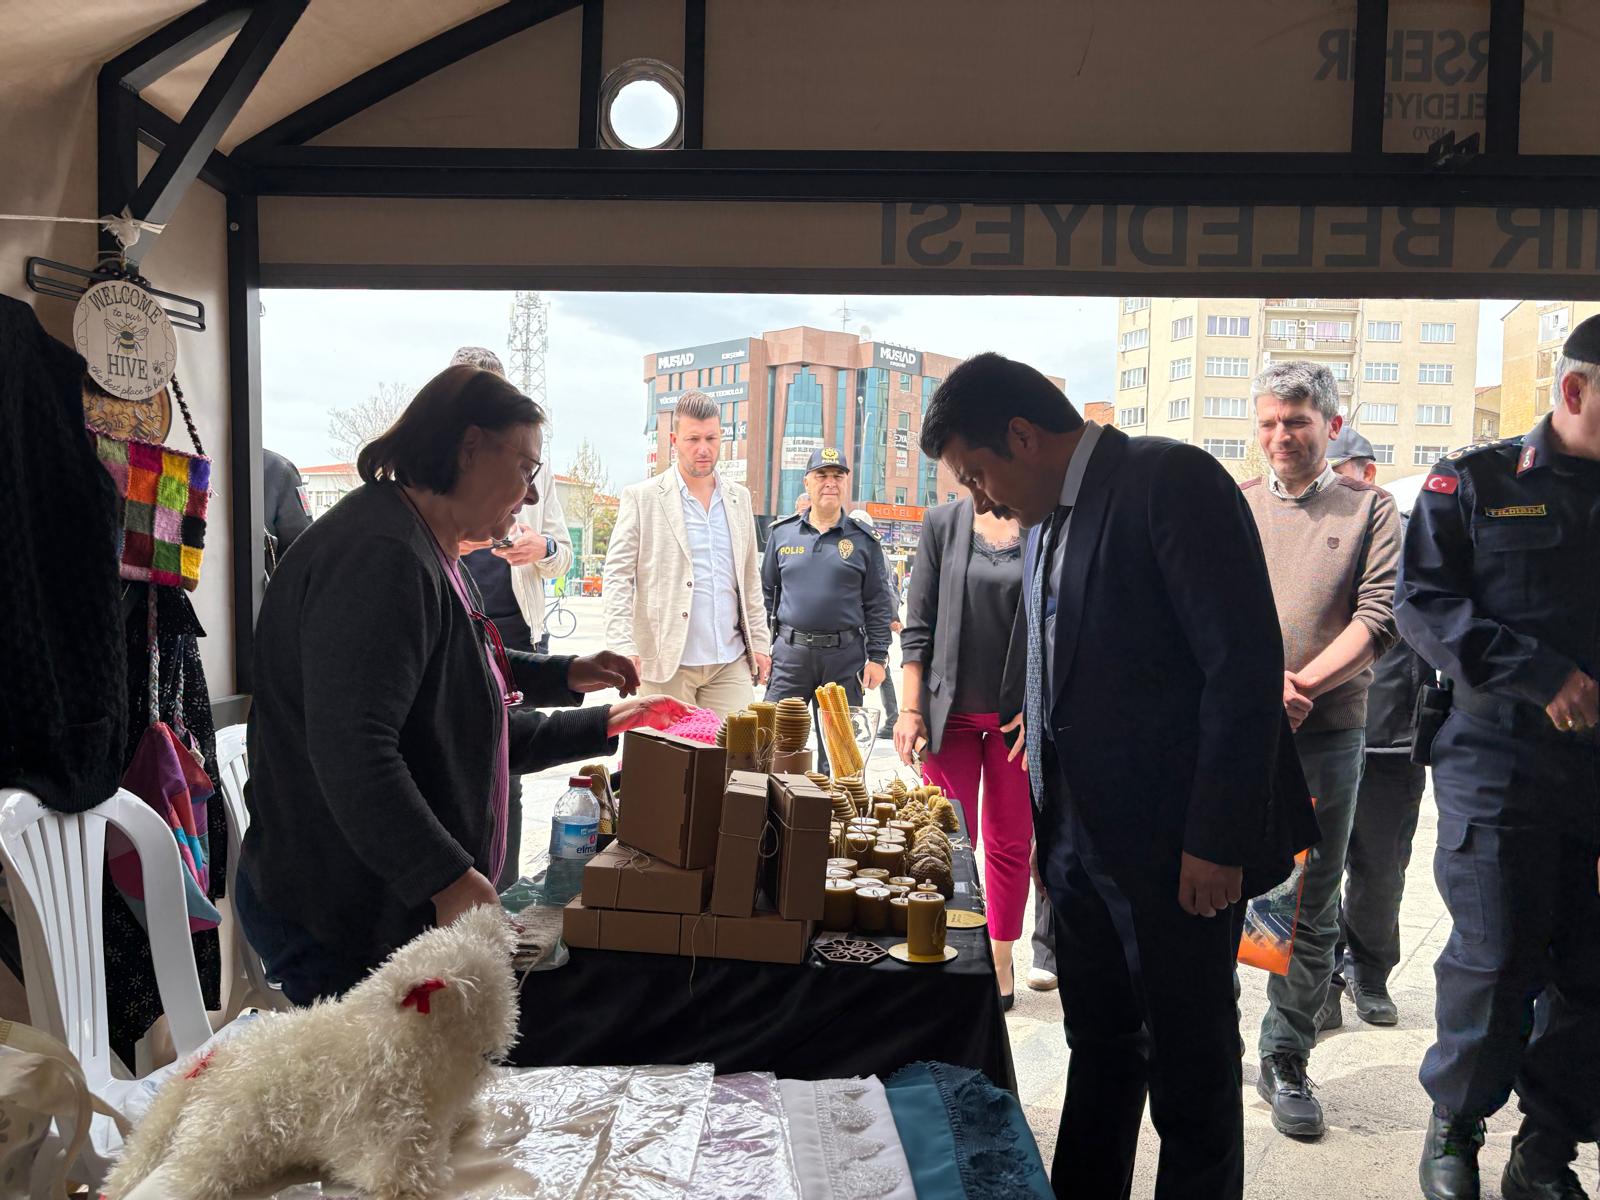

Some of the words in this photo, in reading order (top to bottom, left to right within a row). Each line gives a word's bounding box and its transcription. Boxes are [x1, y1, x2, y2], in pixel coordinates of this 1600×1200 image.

[88, 285, 163, 325] WELCOME
[113, 307, 122, 317] to
[125, 312, 142, 322] our
[107, 354, 148, 380] HIVE
[103, 378, 121, 392] best
[120, 386, 144, 398] place
[873, 507, 913, 518] HOTEL
